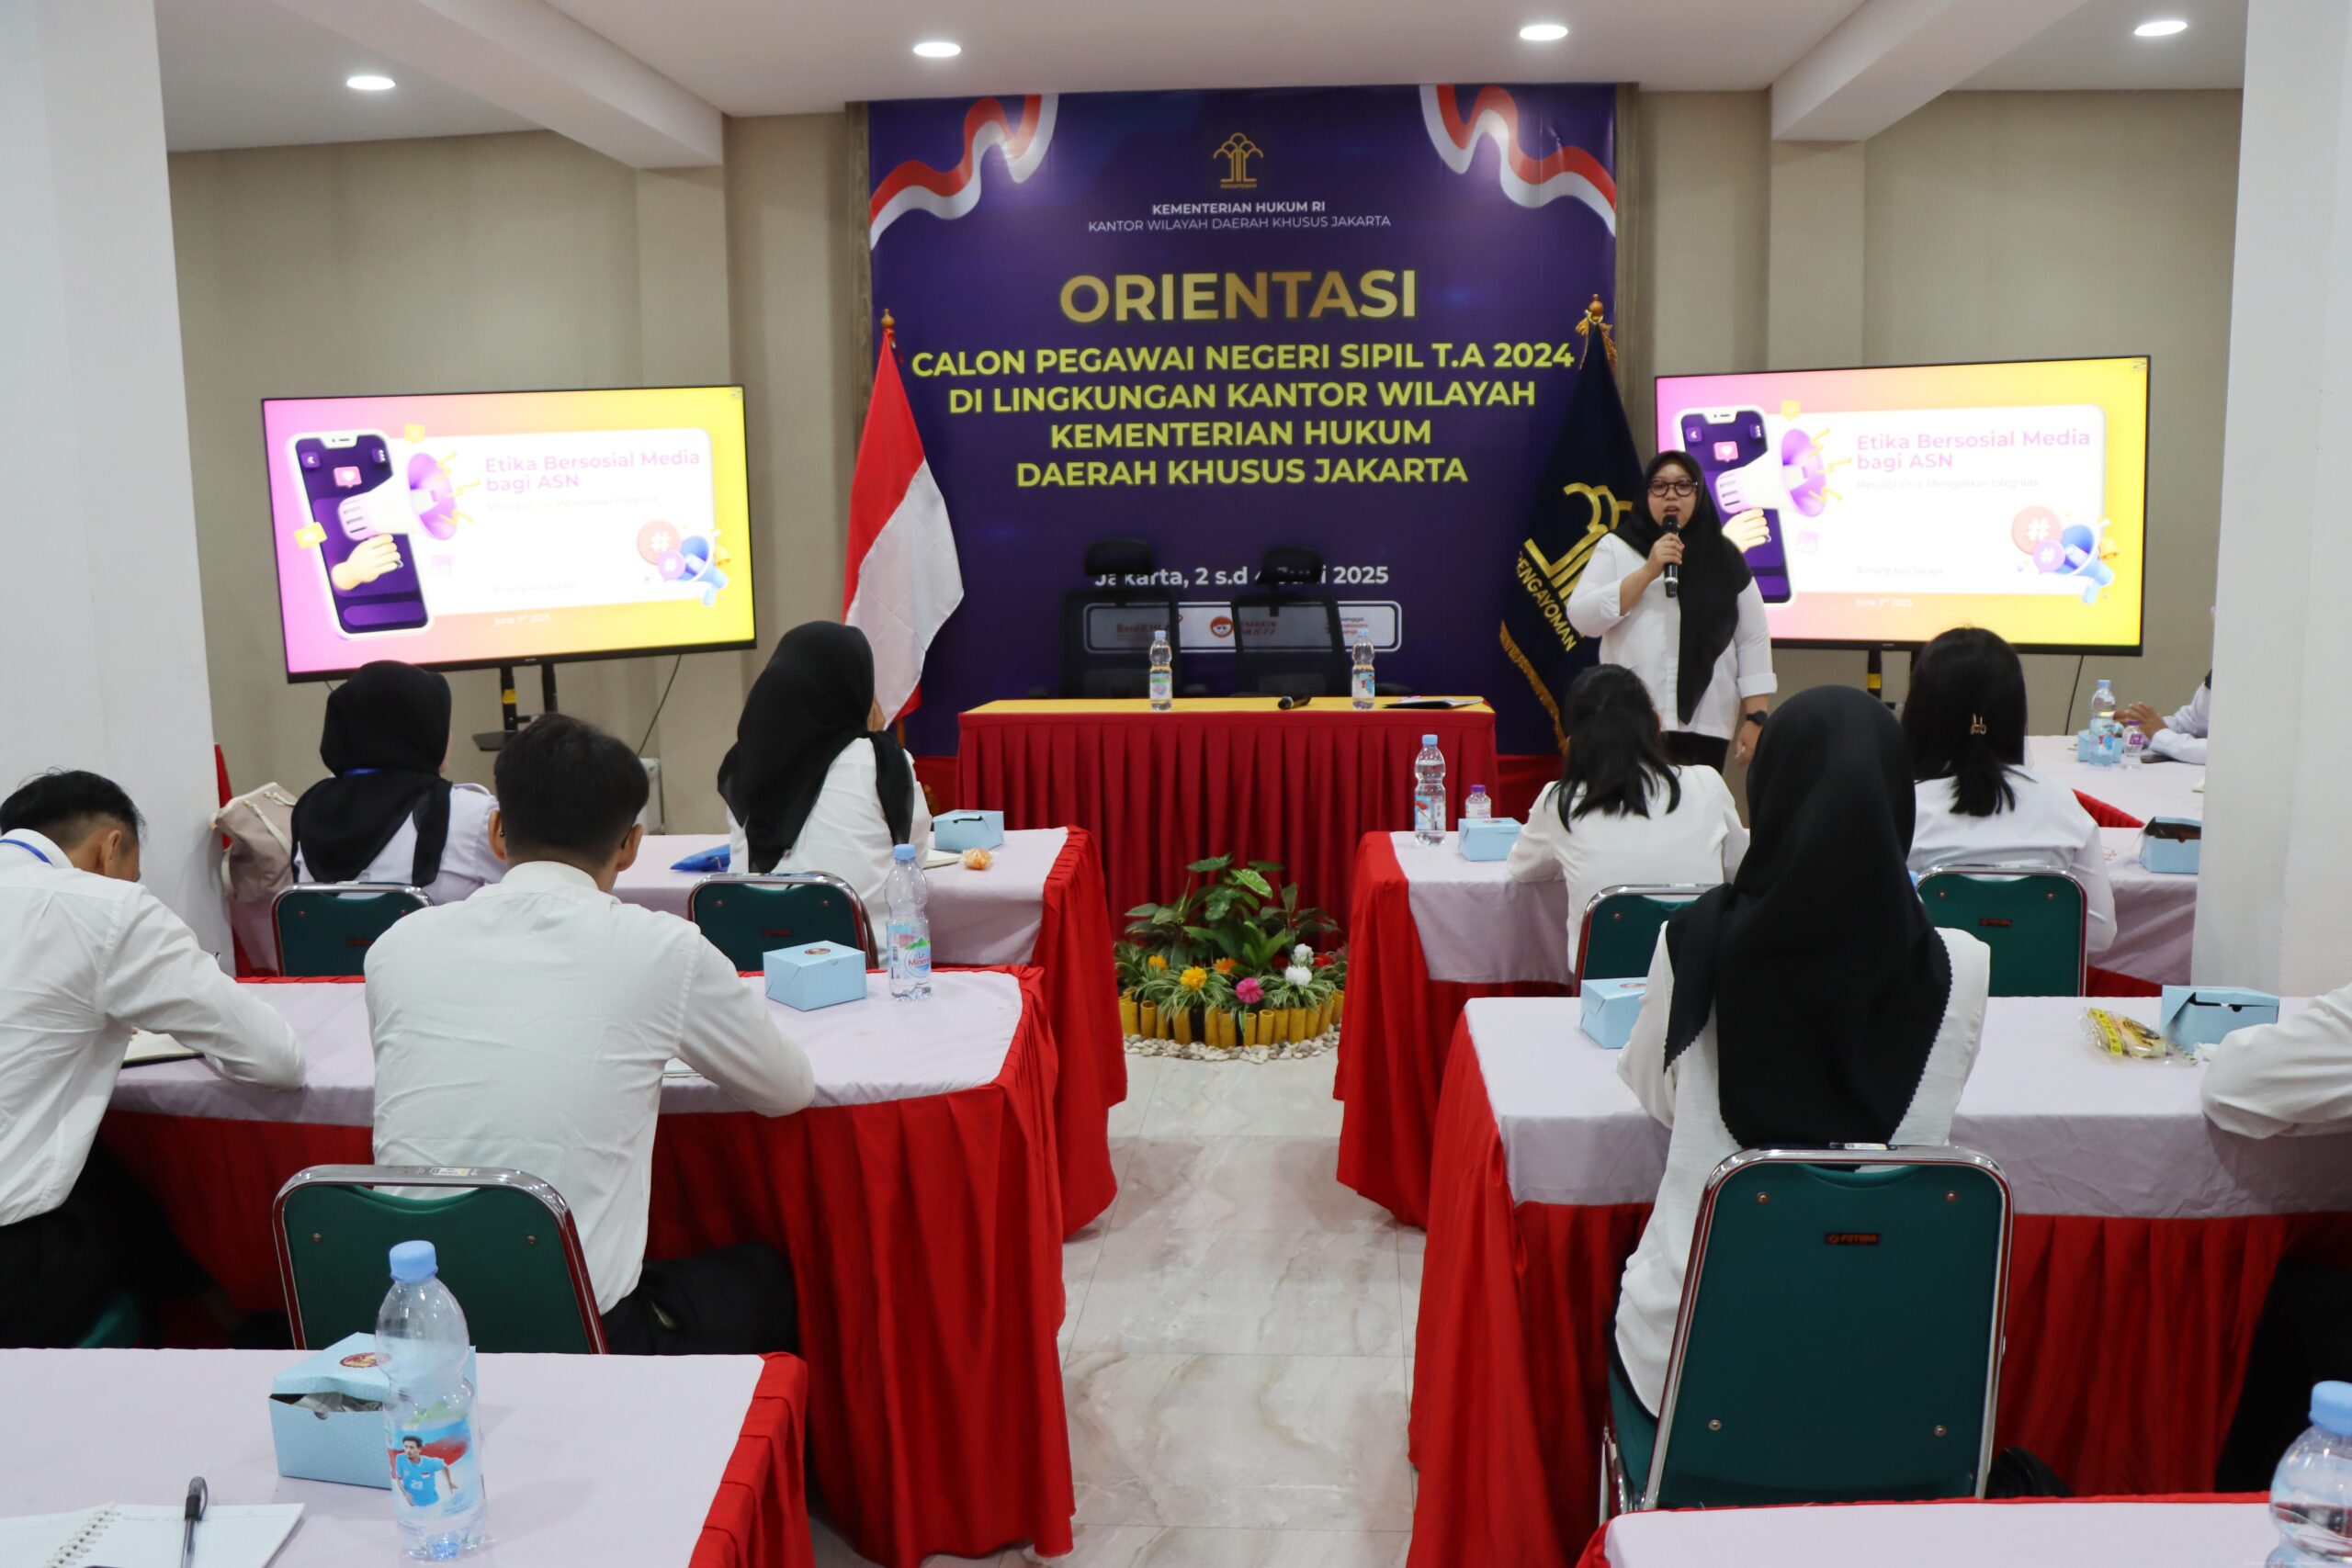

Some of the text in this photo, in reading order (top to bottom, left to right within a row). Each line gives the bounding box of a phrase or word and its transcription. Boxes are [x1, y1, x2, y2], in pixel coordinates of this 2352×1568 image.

[1152, 200, 1326, 215] KEMENTERIAN HUKUM RI
[1089, 215, 1391, 231] KANTOR WILAYAH DAERAH KHUSUS JAKARTA
[1059, 270, 1416, 322] ORIENTASI
[911, 342, 1575, 378] CALON PEGAWAI NEGERI SIPIL T.A 2024
[949, 381, 1535, 413] DI LINGKUNGAN KANTOR WILAYAH
[1051, 419, 1431, 448] KEMENTERIAN HUKUM
[1858, 429, 2090, 450] Etika Bersosial Media
[485, 450, 700, 472] Etika Bersosial Media
[1858, 453, 1953, 472] bagi ASN
[1017, 457, 1468, 487] DAERAH KHUSUS JAKARTA
[487, 474, 579, 494] bagi ASN
[1194, 567, 1209, 585] 2
[1215, 566, 1249, 585] s.d
[1333, 566, 1389, 584] 2025
